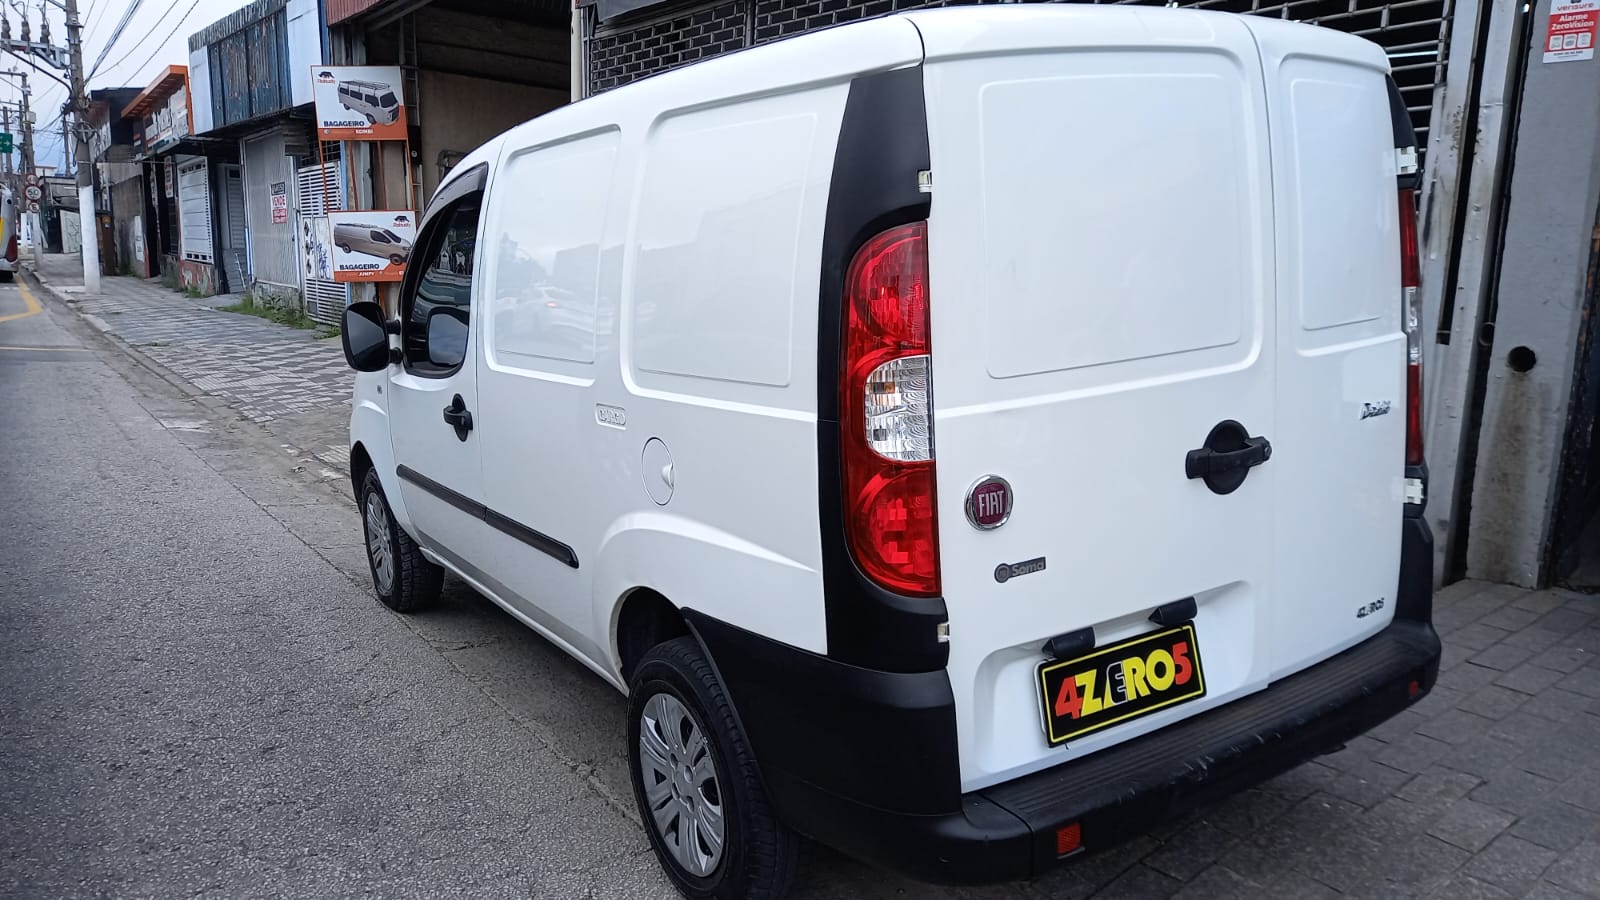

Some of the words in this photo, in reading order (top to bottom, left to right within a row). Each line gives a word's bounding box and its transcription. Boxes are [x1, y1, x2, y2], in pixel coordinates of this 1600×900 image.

[1551, 20, 1594, 29] ZeroVision
[339, 263, 380, 271] BAGAGEIRO
[978, 490, 1005, 518] FIAT
[1055, 641, 1192, 719] 4ZERO5
